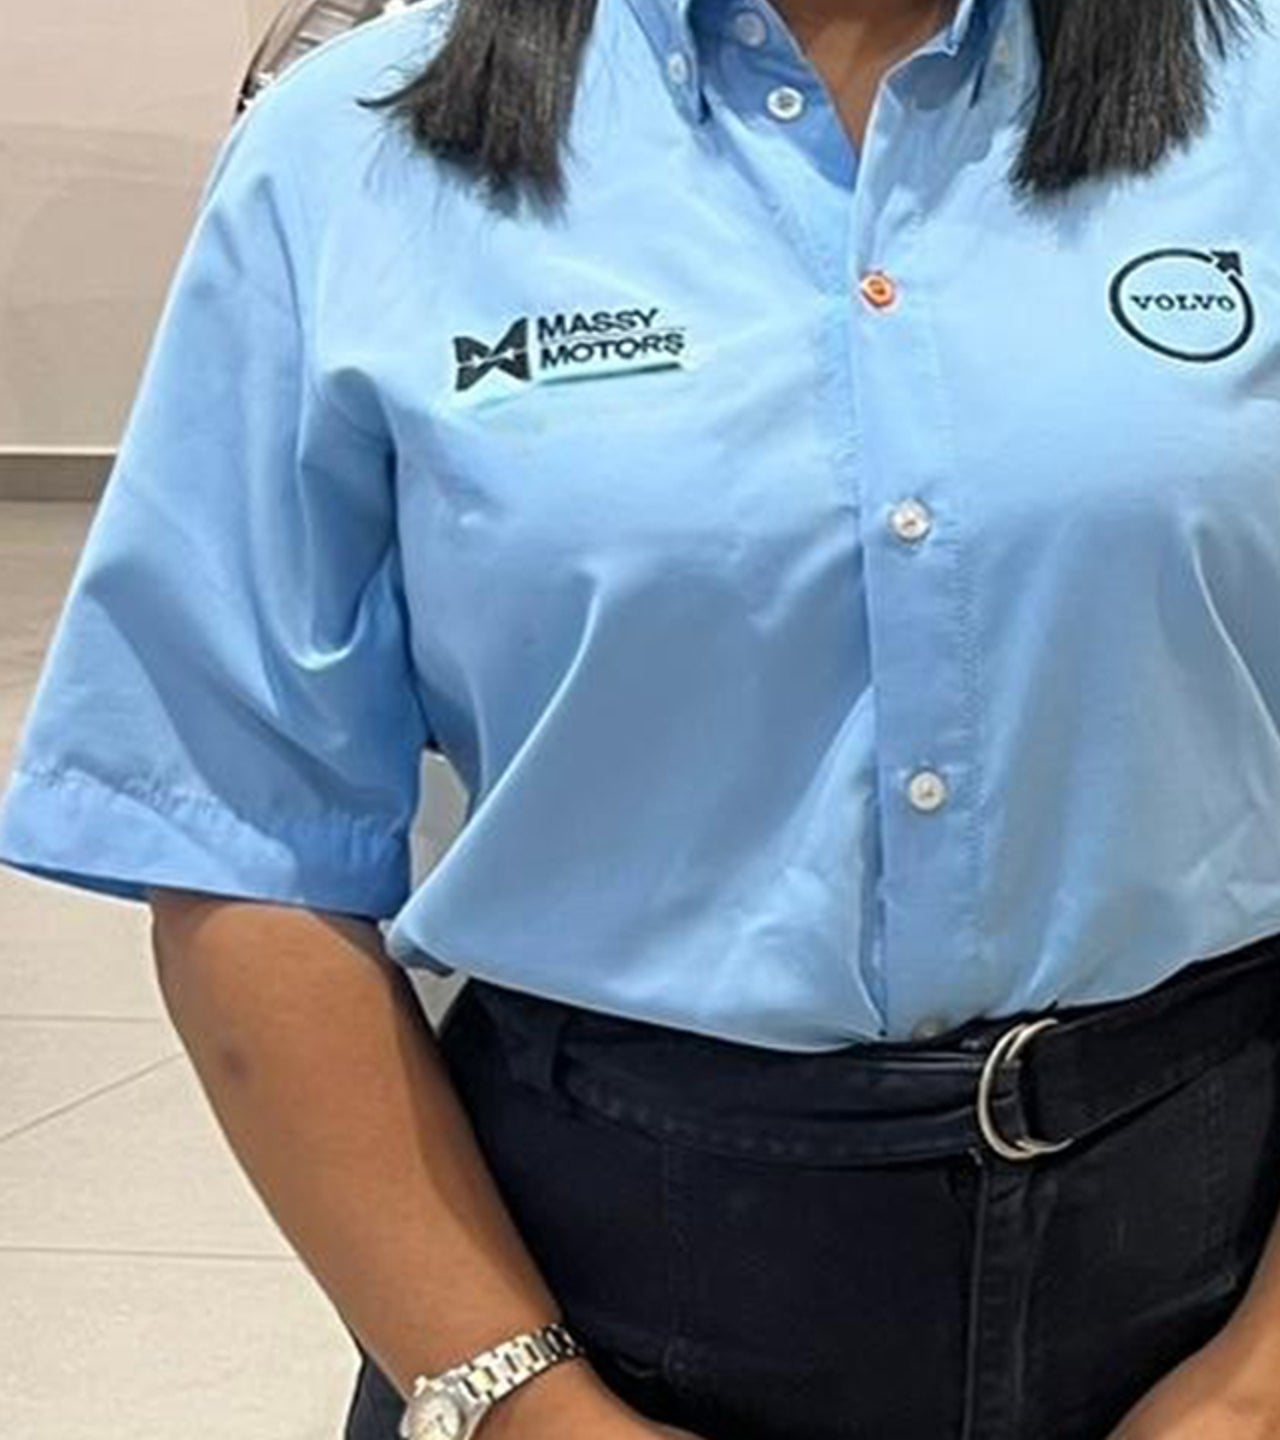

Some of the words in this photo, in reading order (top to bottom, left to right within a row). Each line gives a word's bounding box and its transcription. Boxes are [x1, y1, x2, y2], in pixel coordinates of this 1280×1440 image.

[1130, 293, 1236, 312] VOLVO
[537, 308, 659, 341] MASSY
[540, 333, 685, 370] MOTORS
